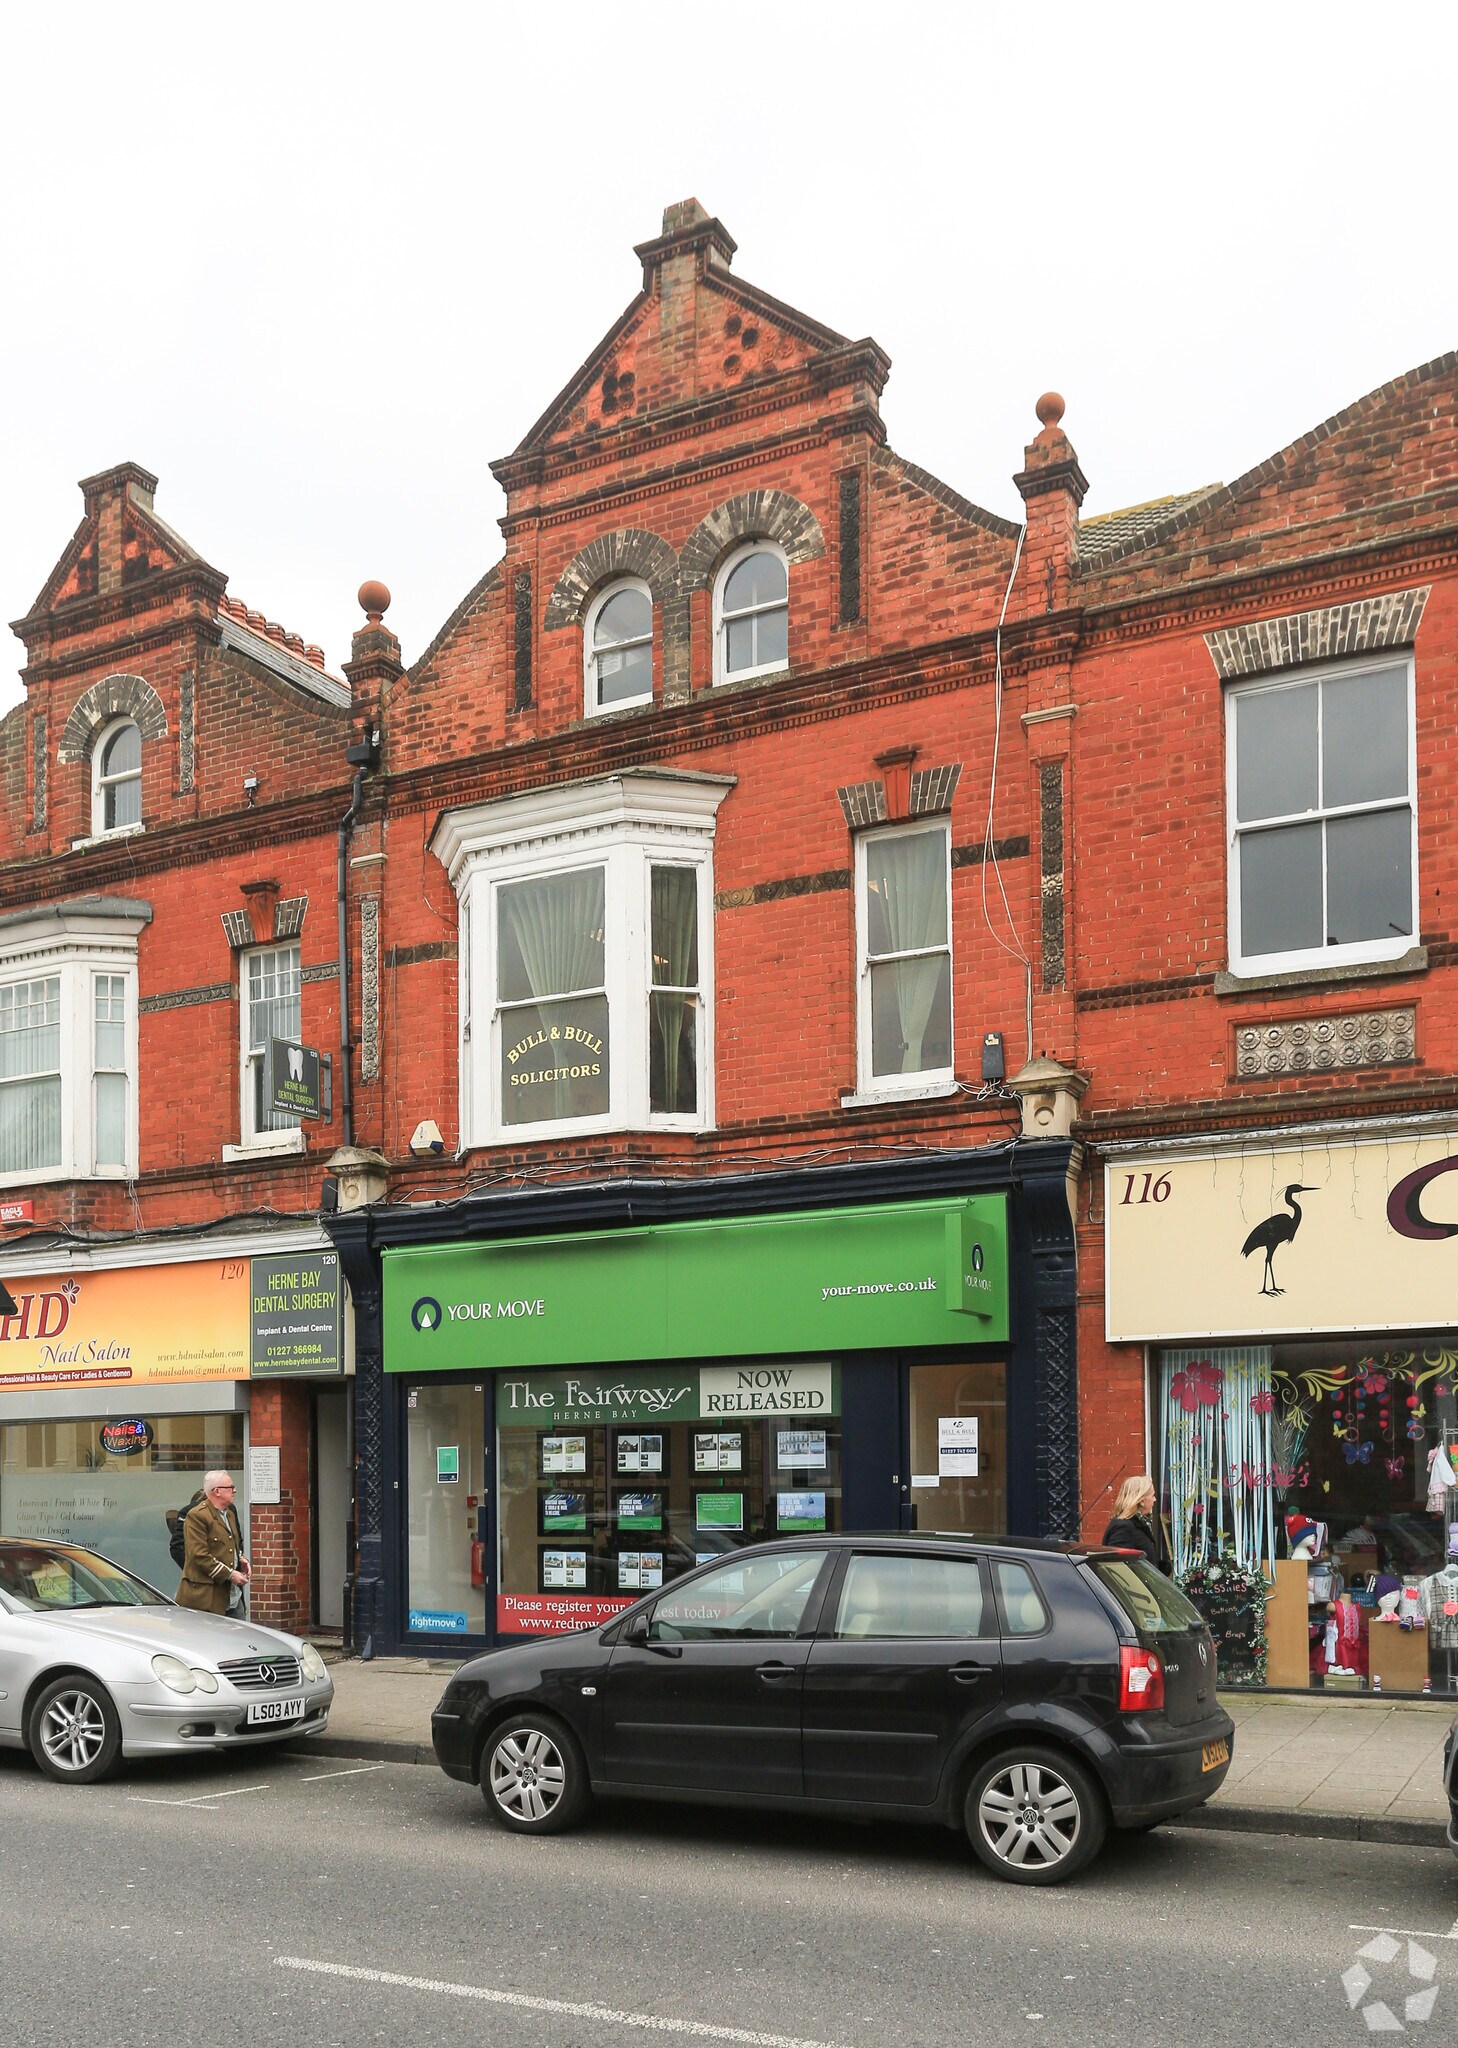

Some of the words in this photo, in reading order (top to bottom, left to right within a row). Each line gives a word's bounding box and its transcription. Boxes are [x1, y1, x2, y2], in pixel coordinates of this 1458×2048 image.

[506, 1030, 548, 1065] BULL
[549, 1026, 561, 1040] &
[563, 1026, 603, 1056] BULL
[510, 1063, 601, 1086] SOLICITORS
[284, 1080, 299, 1092] HERNE
[299, 1085, 309, 1094] BAY
[277, 1090, 295, 1102] DENTAL
[295, 1094, 316, 1106] SURGERY
[1118, 1170, 1172, 1205] 116
[321, 1254, 337, 1265] 120
[219, 1263, 245, 1281] 120
[268, 1273, 299, 1291] HERNE
[301, 1270, 321, 1288] BAY
[964, 1274, 978, 1288] YOUR
[821, 1277, 938, 1301] your-move.co.uk
[254, 1295, 290, 1314] DENTAL
[291, 1291, 336, 1311] SURGERY
[447, 1303, 493, 1321] YOUR
[496, 1299, 545, 1318] MOVE
[0, 1291, 70, 1341] HD
[256, 1326, 281, 1336] Implant
[282, 1326, 287, 1334] &
[288, 1324, 310, 1333] Dental
[310, 1323, 333, 1332] Centre
[38, 1341, 83, 1368] Nail
[82, 1338, 131, 1364] Salon
[157, 1348, 244, 1362] www.hdnailsalon.com
[267, 1346, 291, 1356] 01227
[293, 1343, 322, 1355] 366984
[148, 1363, 244, 1378] hdnailsalon@gmail.com
[253, 1356, 337, 1368] www.hernebaydental.com
[42, 1372, 58, 1382] Beauty
[58, 1371, 71, 1380] Care
[71, 1370, 80, 1380] For
[80, 1369, 97, 1379] Ladies
[103, 1368, 131, 1378] Gentlemen
[737, 1369, 793, 1389] NOW
[503, 1382, 555, 1409] The
[565, 1380, 692, 1413] Fairways
[706, 1390, 824, 1412] RELEASED
[553, 1410, 601, 1420] HERNE
[612, 1409, 638, 1419] BAY
[106, 1435, 148, 1447] Waxing
[504, 1597, 543, 1610] Please
[545, 1600, 592, 1615] register
[683, 1605, 722, 1619] today
[411, 1616, 456, 1628] rightmove
[253, 1703, 282, 1720] LS03
[284, 1700, 302, 1717] AYY
